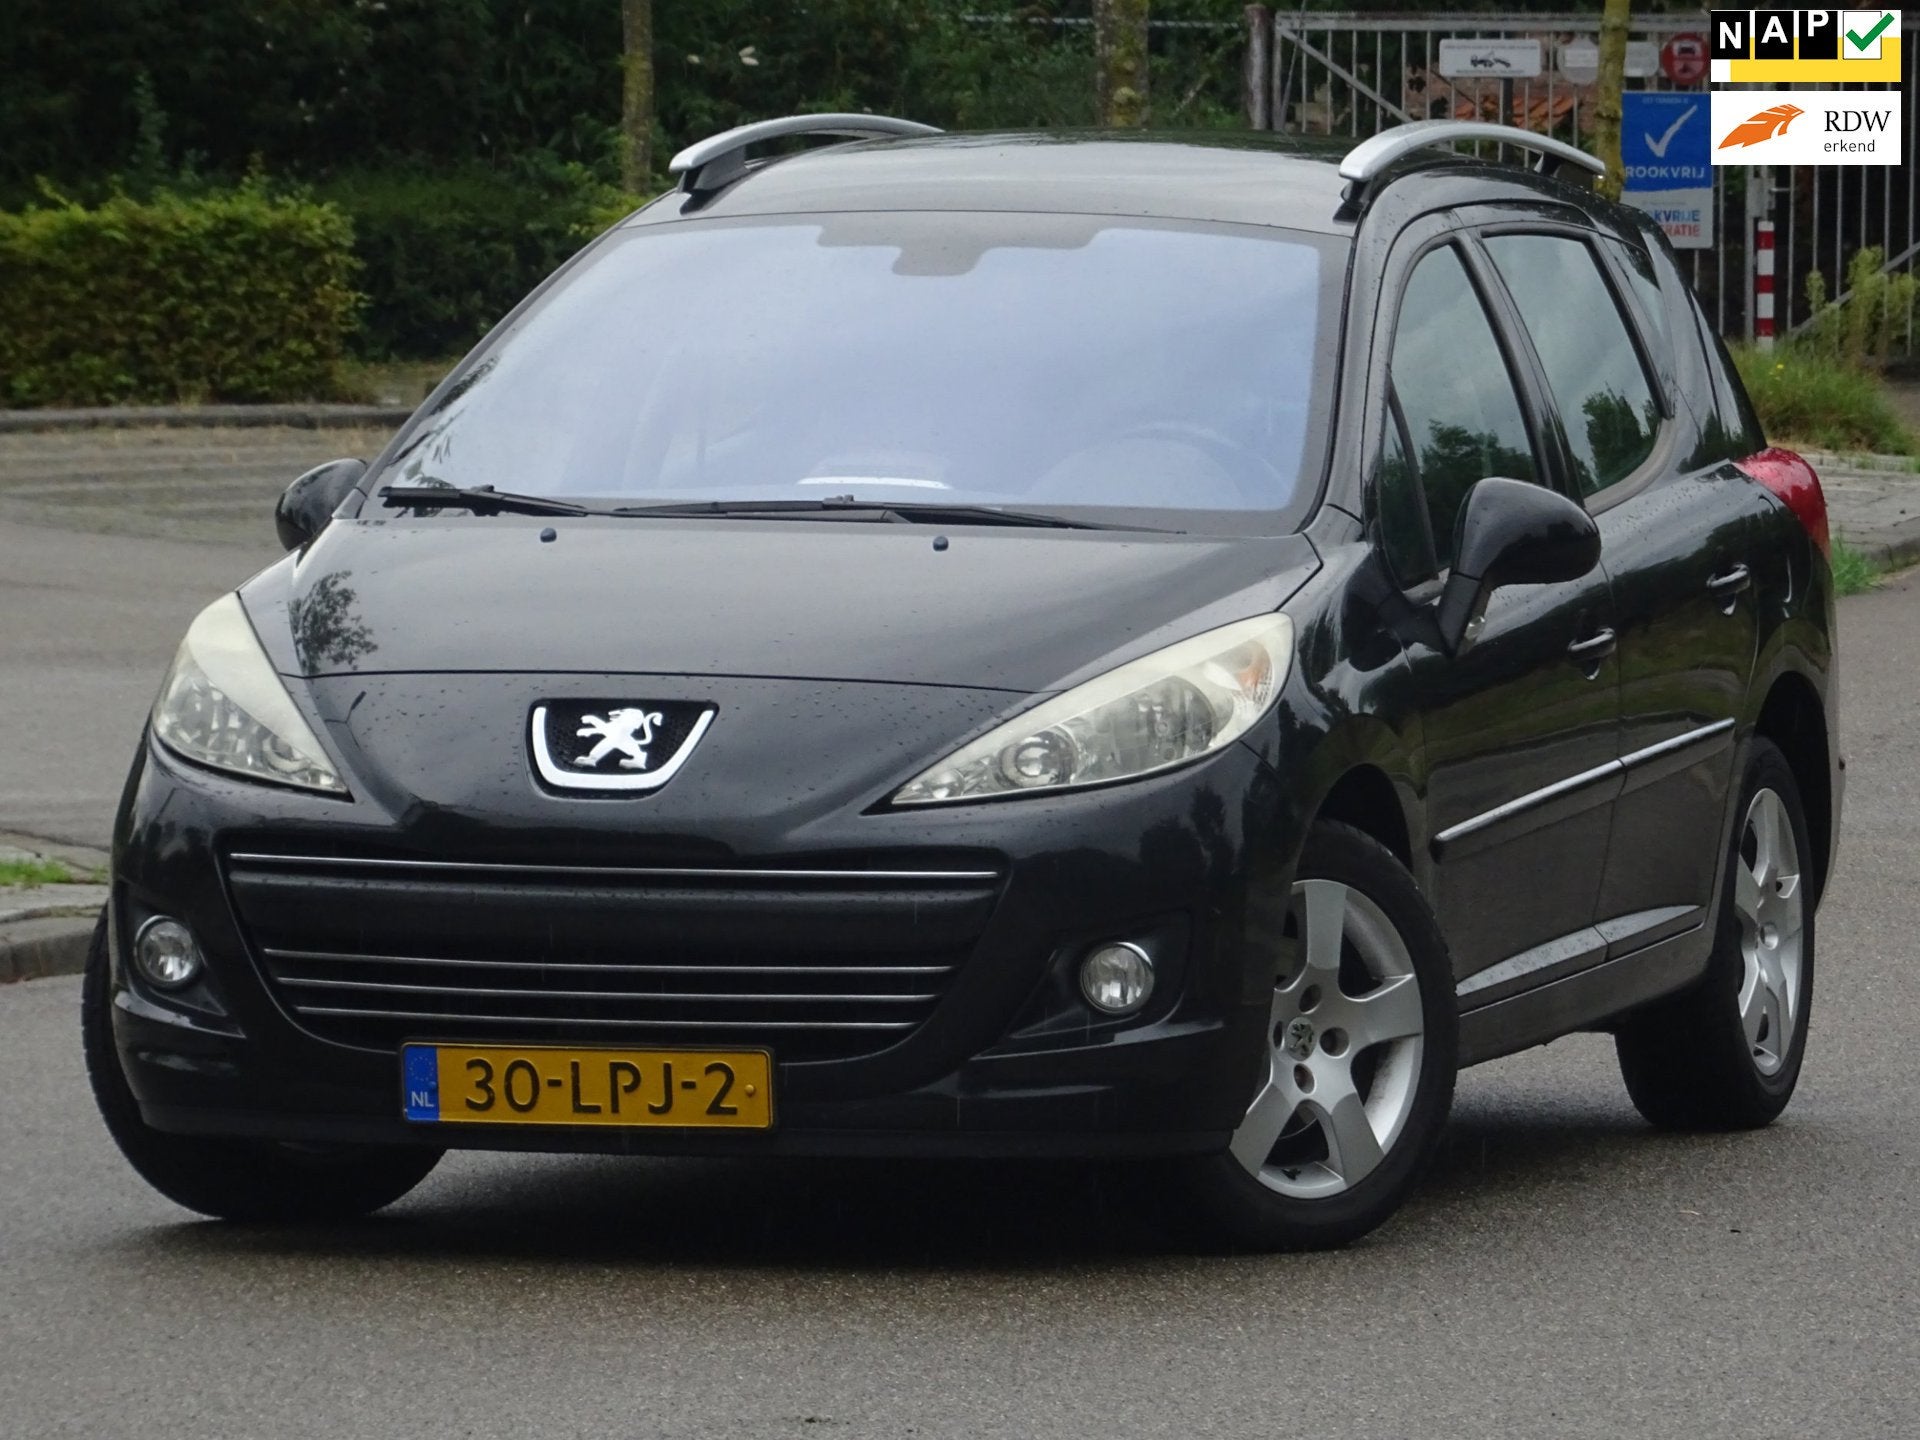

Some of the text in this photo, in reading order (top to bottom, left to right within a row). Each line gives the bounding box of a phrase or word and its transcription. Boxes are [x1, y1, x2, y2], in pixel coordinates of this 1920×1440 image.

[1625, 165, 1705, 179] ROOKVRIJ
[1652, 209, 1700, 222] KVRIJE
[1663, 223, 1700, 237] RATIE
[464, 1057, 738, 1117] 30-LPJ-2
[411, 1091, 434, 1108] NL
